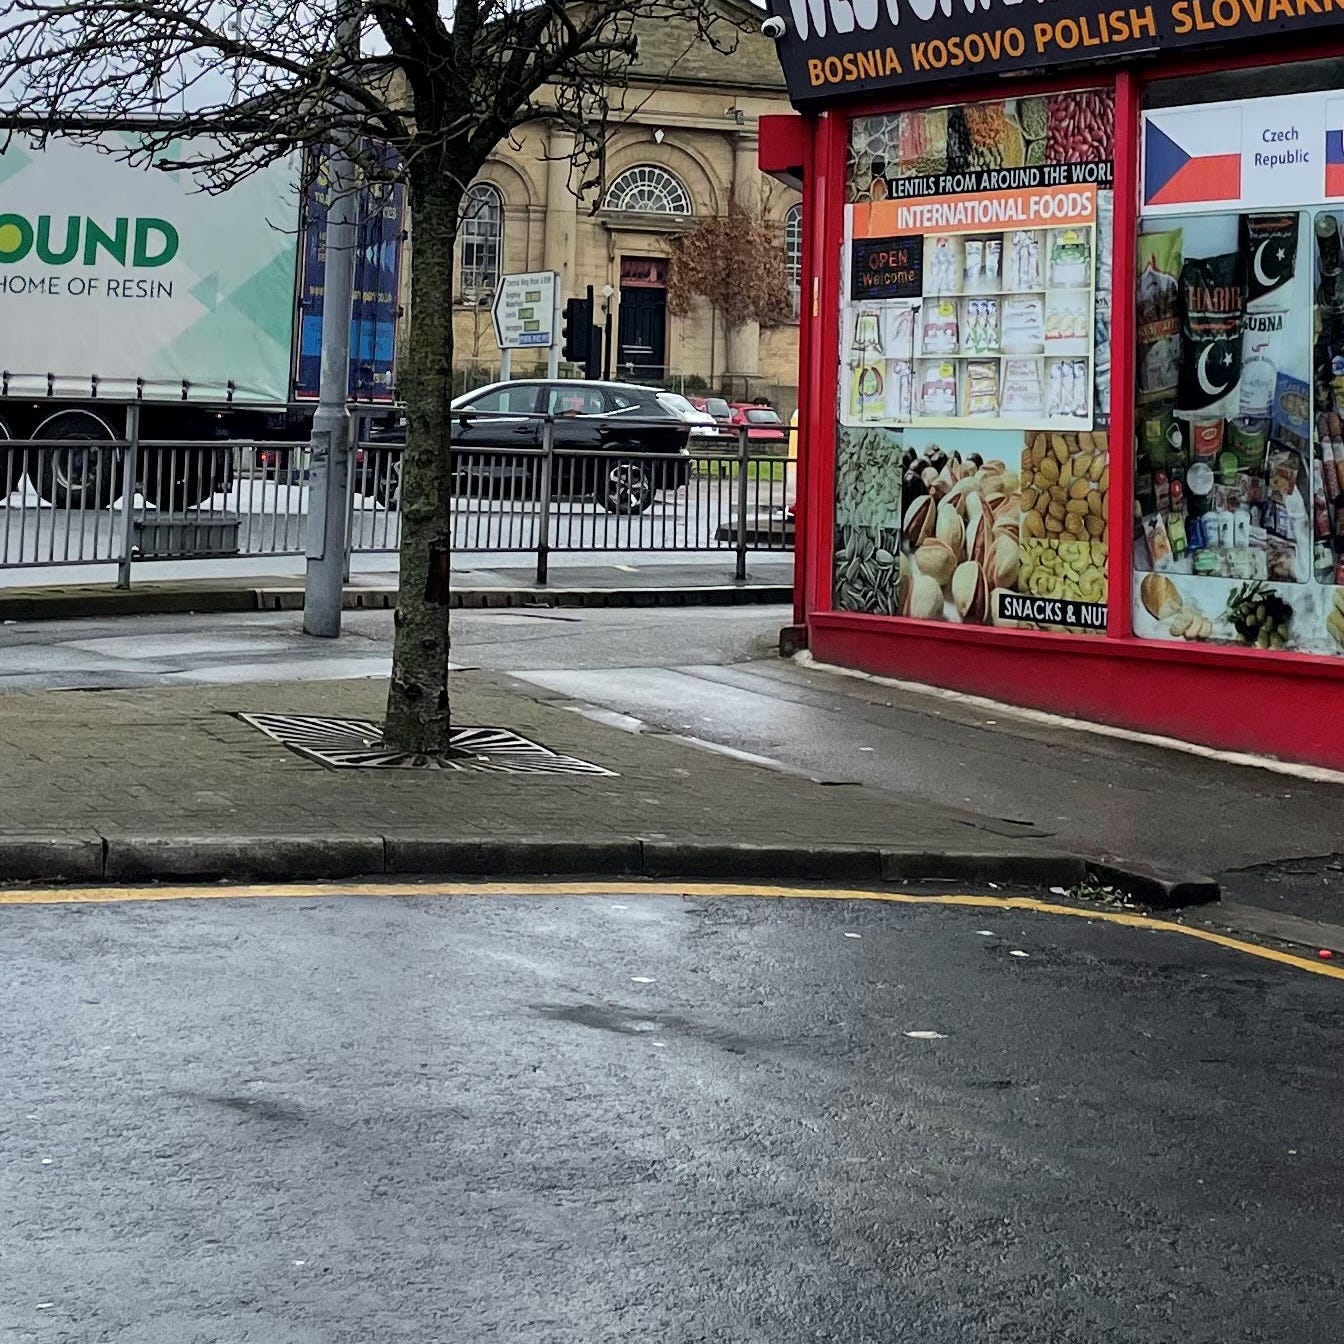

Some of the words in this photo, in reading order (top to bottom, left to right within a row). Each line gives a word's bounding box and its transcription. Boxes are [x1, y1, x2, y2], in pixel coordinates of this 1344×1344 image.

[807, 46, 903, 88] BOSNIA
[910, 26, 1026, 72] KOSOVO
[1034, 5, 1157, 53] POLISH
[1262, 126, 1299, 143] Czech
[1254, 149, 1309, 169] Republic
[892, 177, 935, 197] LENTILS
[939, 174, 977, 193] FROM
[979, 168, 1040, 191] AROUND
[1043, 166, 1068, 185] THE
[1071, 162, 1113, 183] WORL
[897, 197, 1027, 229] INTERNATIONAL
[1029, 191, 1092, 218] FOODS
[869, 249, 907, 270] OPEN
[67, 276, 99, 297] OF
[106, 278, 174, 299] RESIN
[862, 269, 916, 287] Welcome
[1004, 597, 1062, 622] SNACKS
[1066, 604, 1076, 623] &
